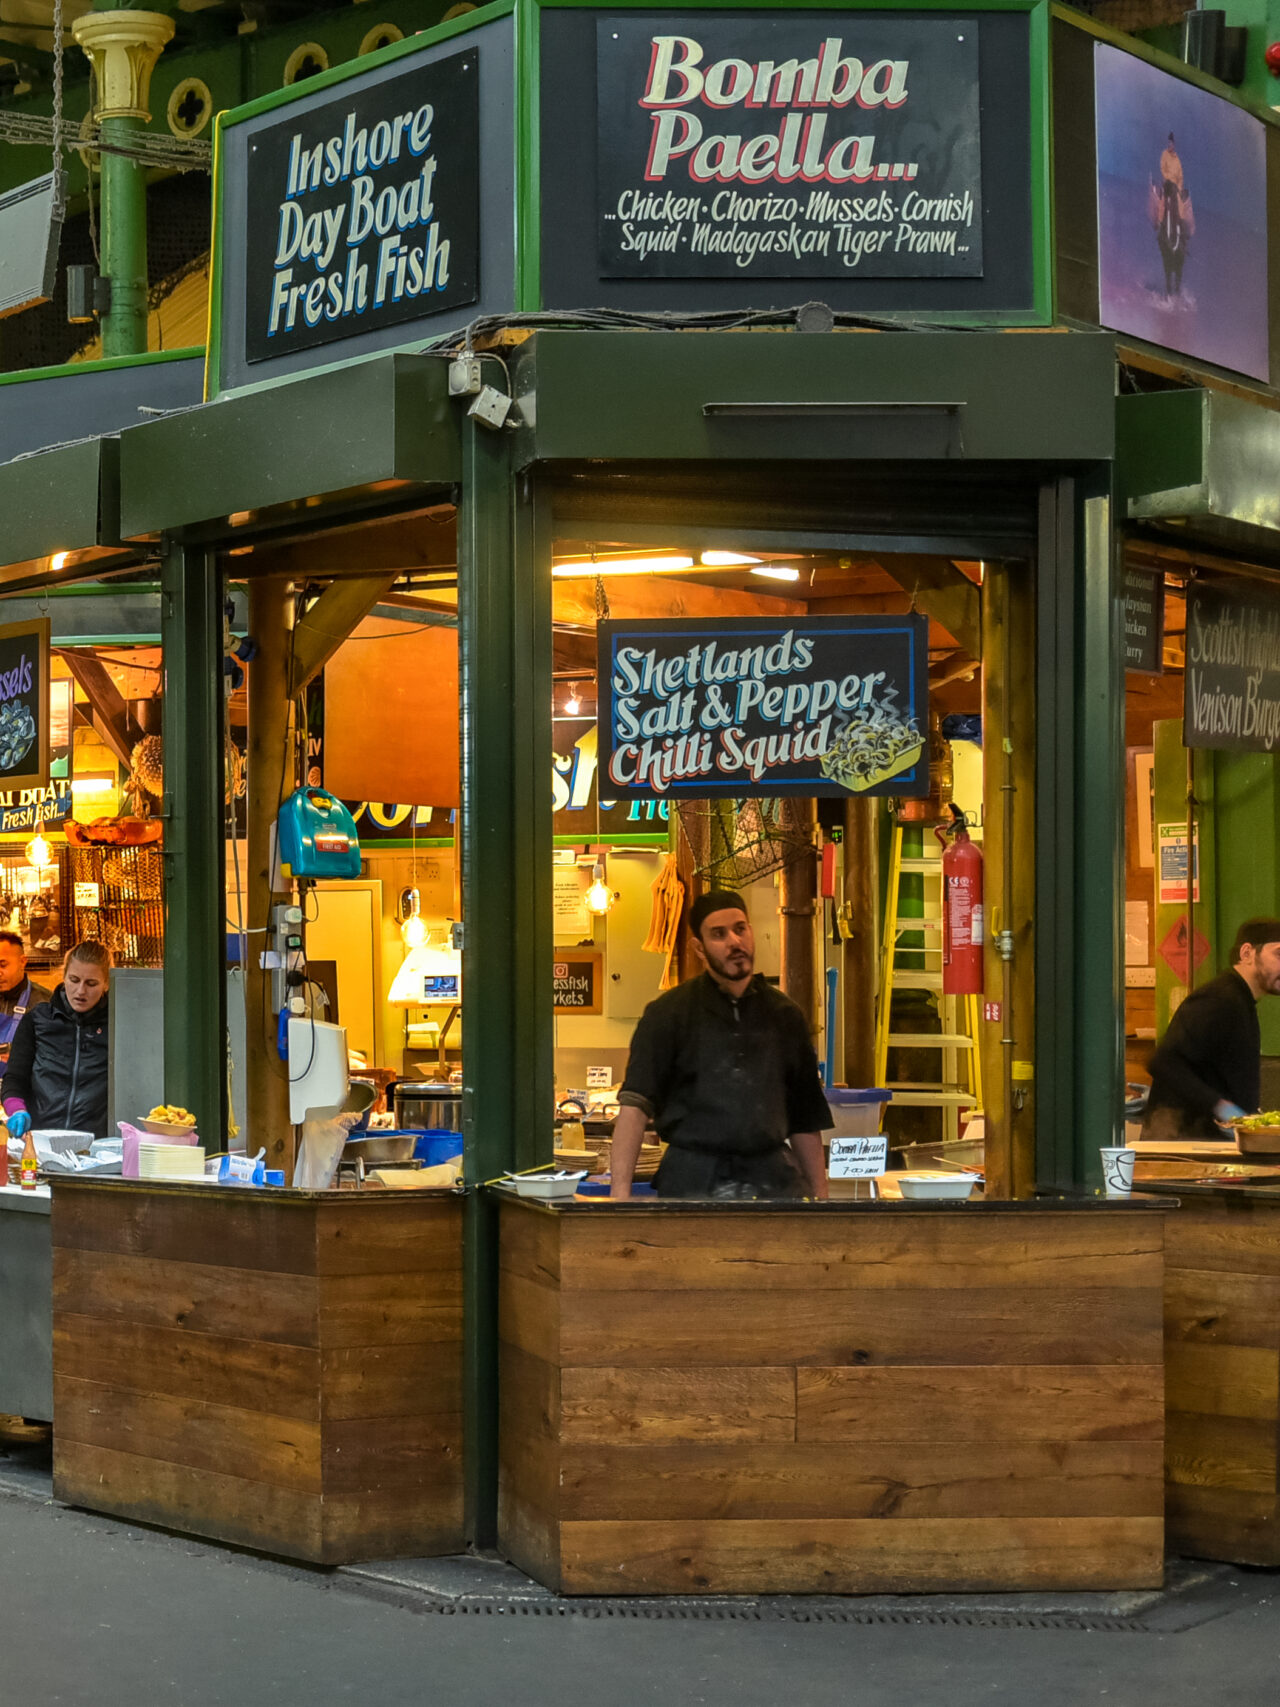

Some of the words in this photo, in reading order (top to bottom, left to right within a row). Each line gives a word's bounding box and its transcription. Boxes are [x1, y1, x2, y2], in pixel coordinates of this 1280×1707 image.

[638, 36, 909, 109] Bomba
[286, 104, 434, 199] Inshore
[644, 110, 918, 184] Paella...
[274, 201, 346, 271] Day
[346, 154, 437, 246] Boat
[712, 191, 797, 222] Chorizo
[805, 191, 893, 223] Mussels
[901, 190, 973, 227] Cornish
[267, 248, 368, 336] Fresh
[373, 222, 450, 309] Fish
[621, 223, 681, 261] Squid
[690, 222, 828, 267] Madagaskan
[833, 223, 891, 267] Tiger
[894, 223, 970, 253] Prawn...
[611, 629, 815, 699] Shetlands
[1190, 599, 1245, 667] Scottish
[614, 689, 697, 741] Salt
[699, 684, 734, 728] &
[734, 671, 886, 726] Pepper
[1191, 668, 1242, 737] Venison
[609, 731, 713, 794] Chilli
[716, 713, 833, 781] Squid
[2, 807, 34, 830] Fresh
[553, 975, 588, 992] essfish
[553, 990, 584, 1006] rkets
